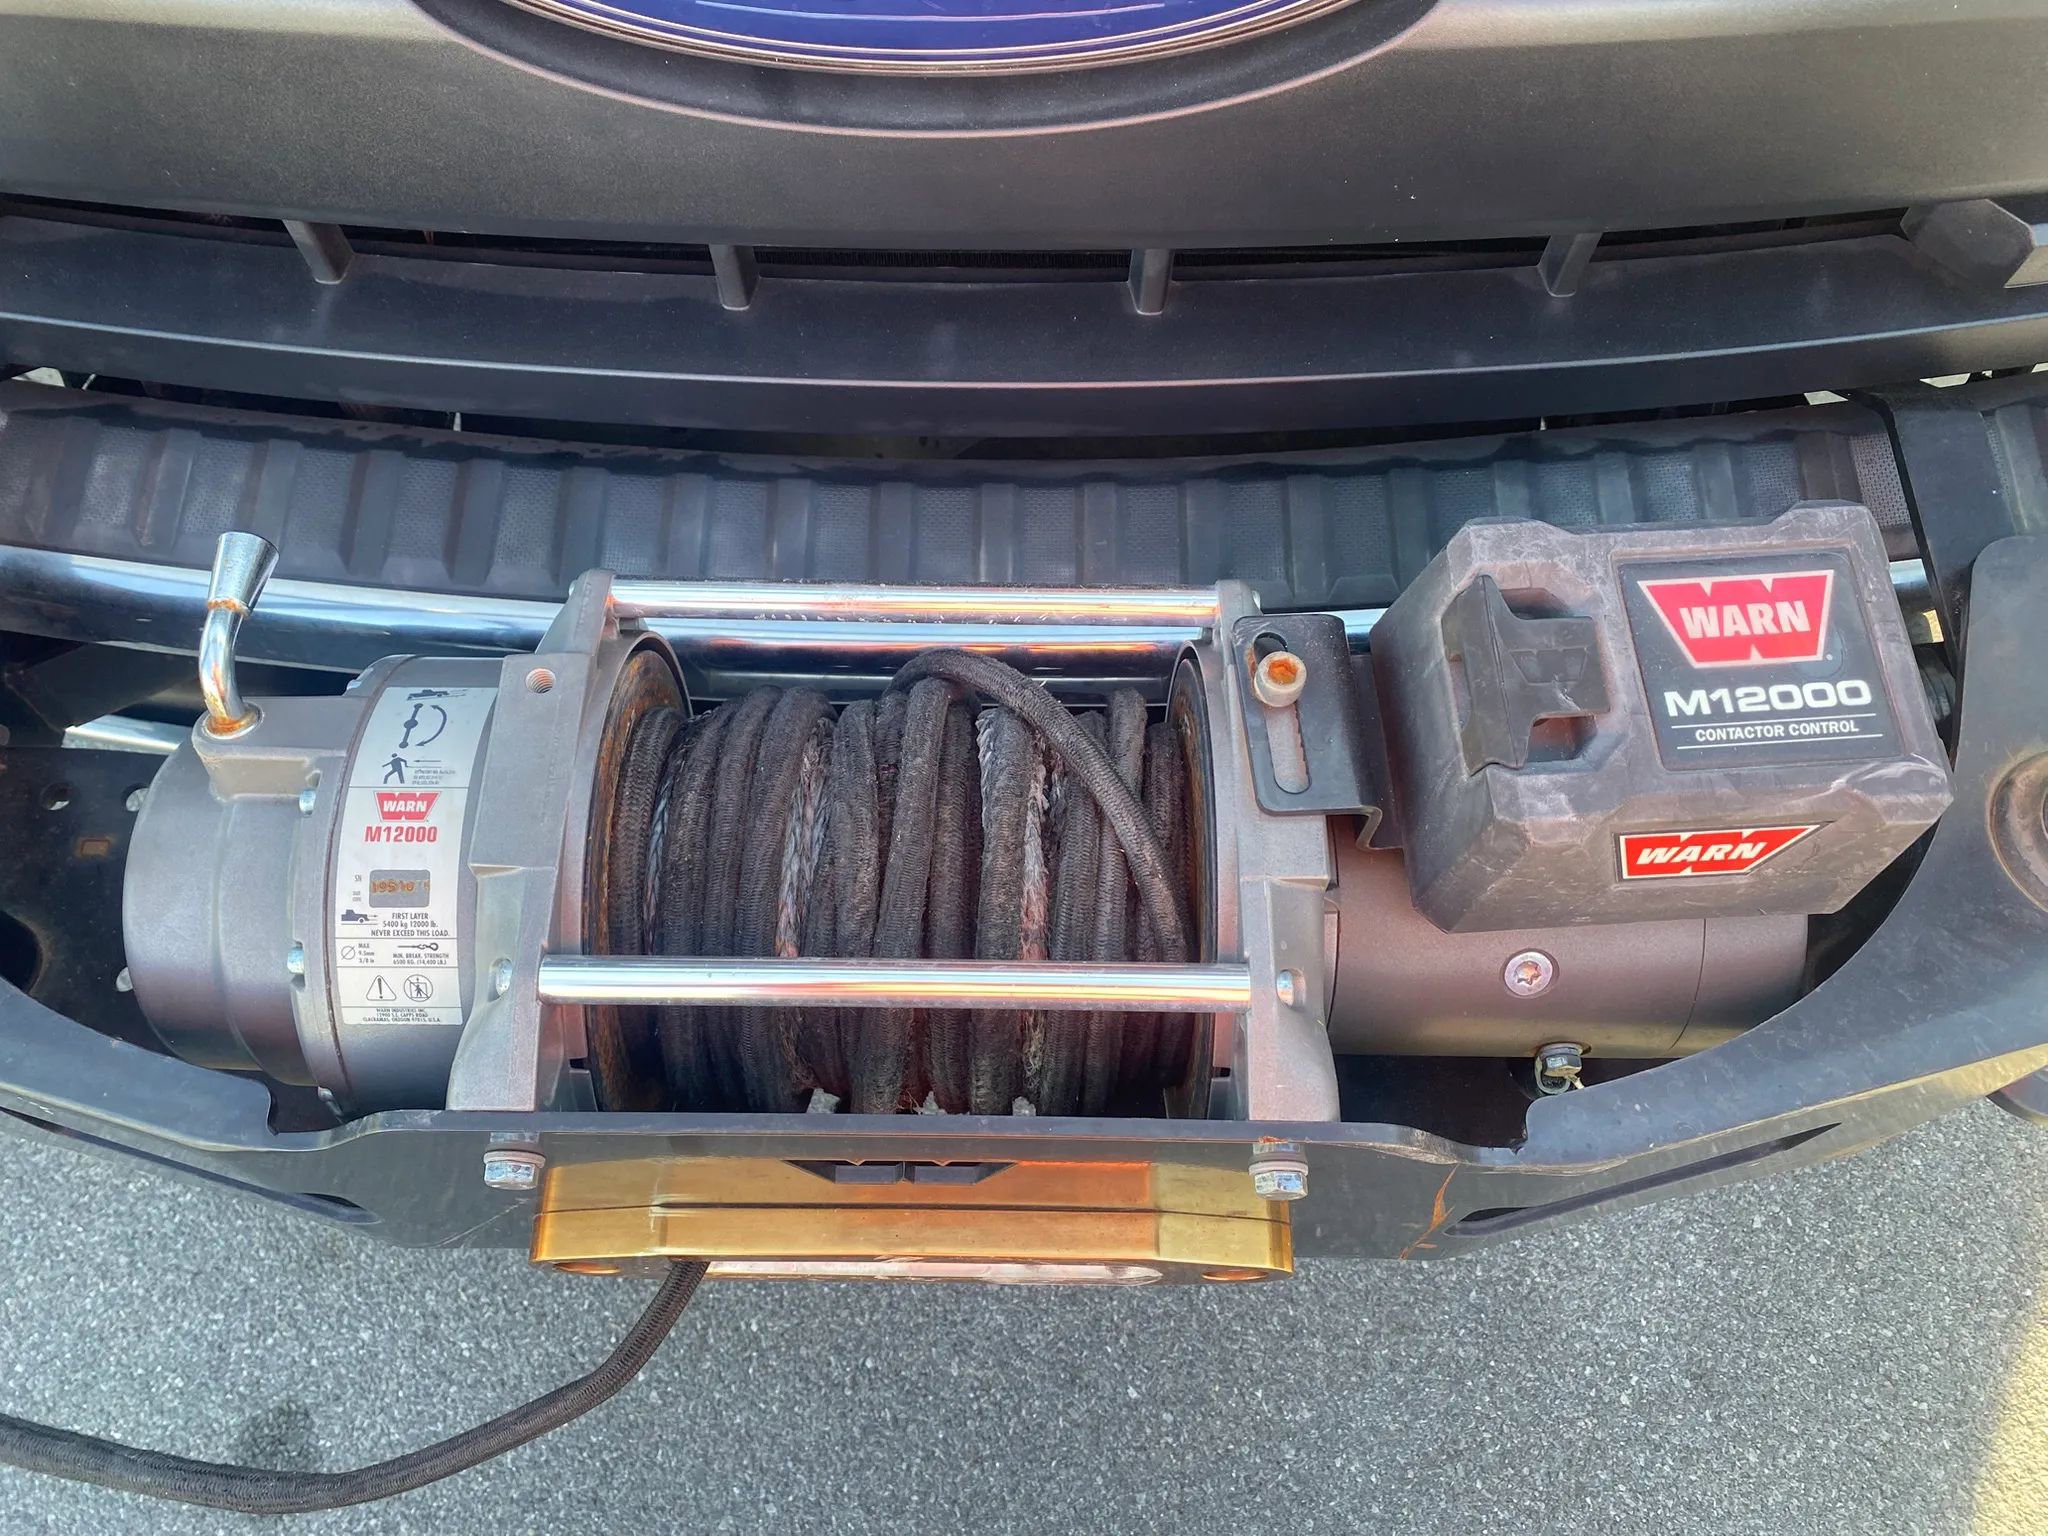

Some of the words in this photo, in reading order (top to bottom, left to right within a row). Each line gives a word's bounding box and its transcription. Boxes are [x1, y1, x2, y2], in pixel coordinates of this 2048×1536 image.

[1680, 600, 1811, 639] WARN
[1664, 679, 1872, 717] M12000
[1695, 725, 1785, 742] CONTACTOR
[1789, 719, 1860, 736] CONTROL
[383, 800, 427, 812] WARN
[364, 826, 438, 843] M12000
[1636, 842, 1766, 864] WARN
[383, 920, 399, 928] 5400
[400, 920, 408, 929] kg
[410, 920, 429, 928] 12000
[392, 912, 408, 920] FIRST
[410, 912, 429, 920] LAYER
[371, 929, 391, 937] NEVER
[392, 929, 415, 937] EXCEED
[416, 929, 430, 937] THIS
[431, 929, 450, 937] LOAD.
